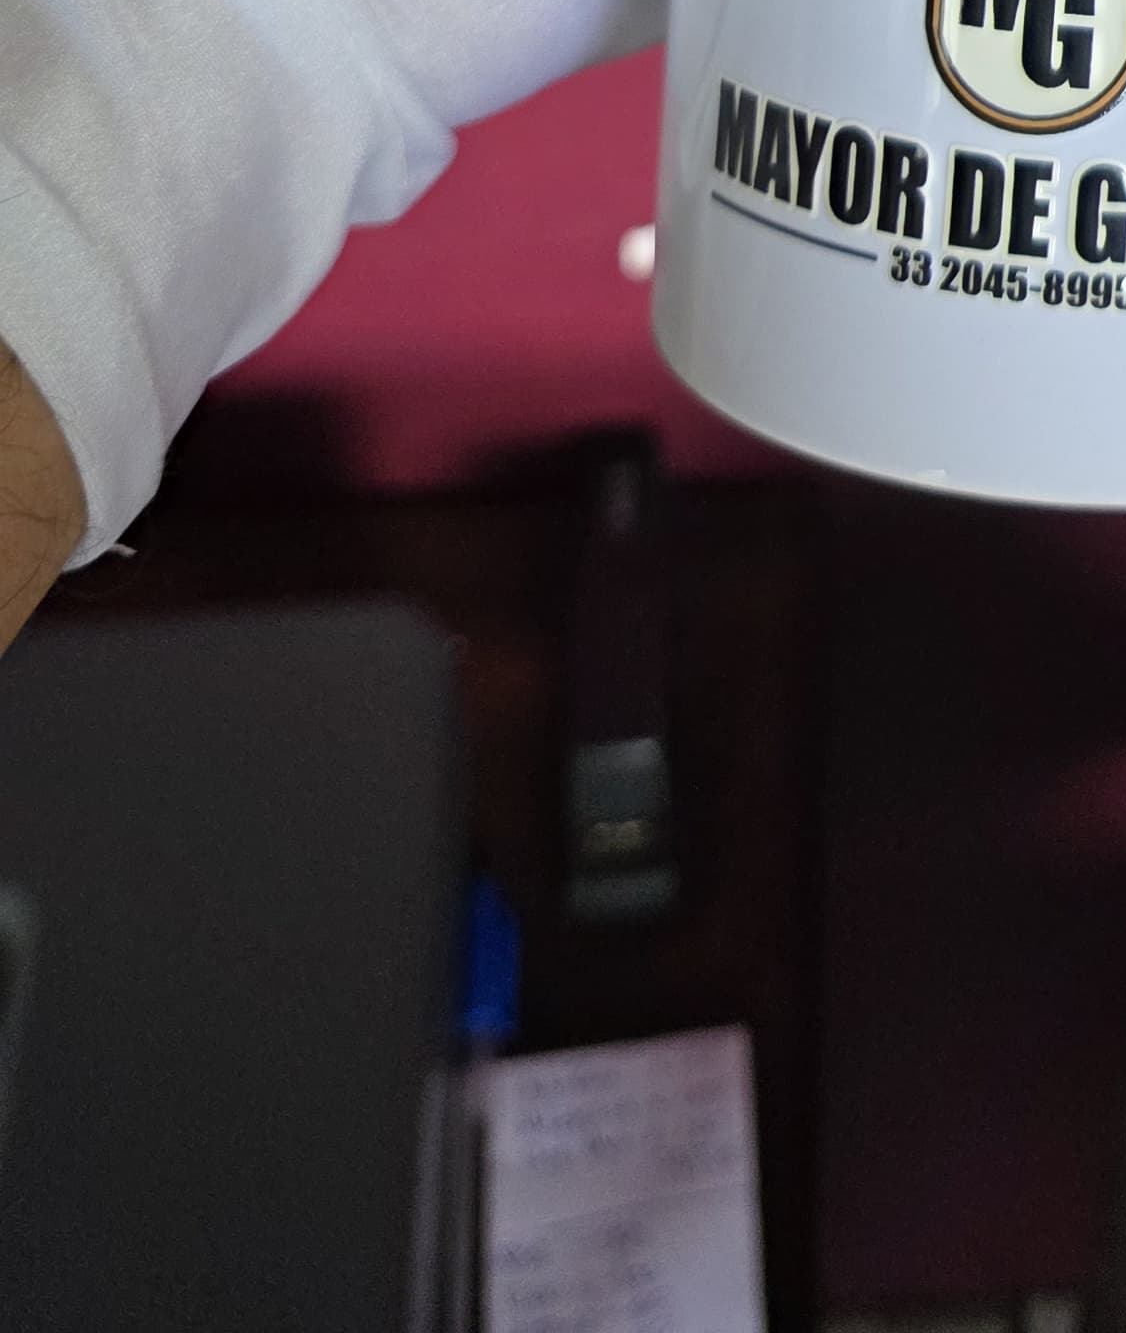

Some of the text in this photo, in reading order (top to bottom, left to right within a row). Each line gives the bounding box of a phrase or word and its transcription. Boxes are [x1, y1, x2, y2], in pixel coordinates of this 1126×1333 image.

[714, 77, 929, 240] MAYOR
[947, 147, 1054, 259] DE
[890, 244, 933, 287] 33
